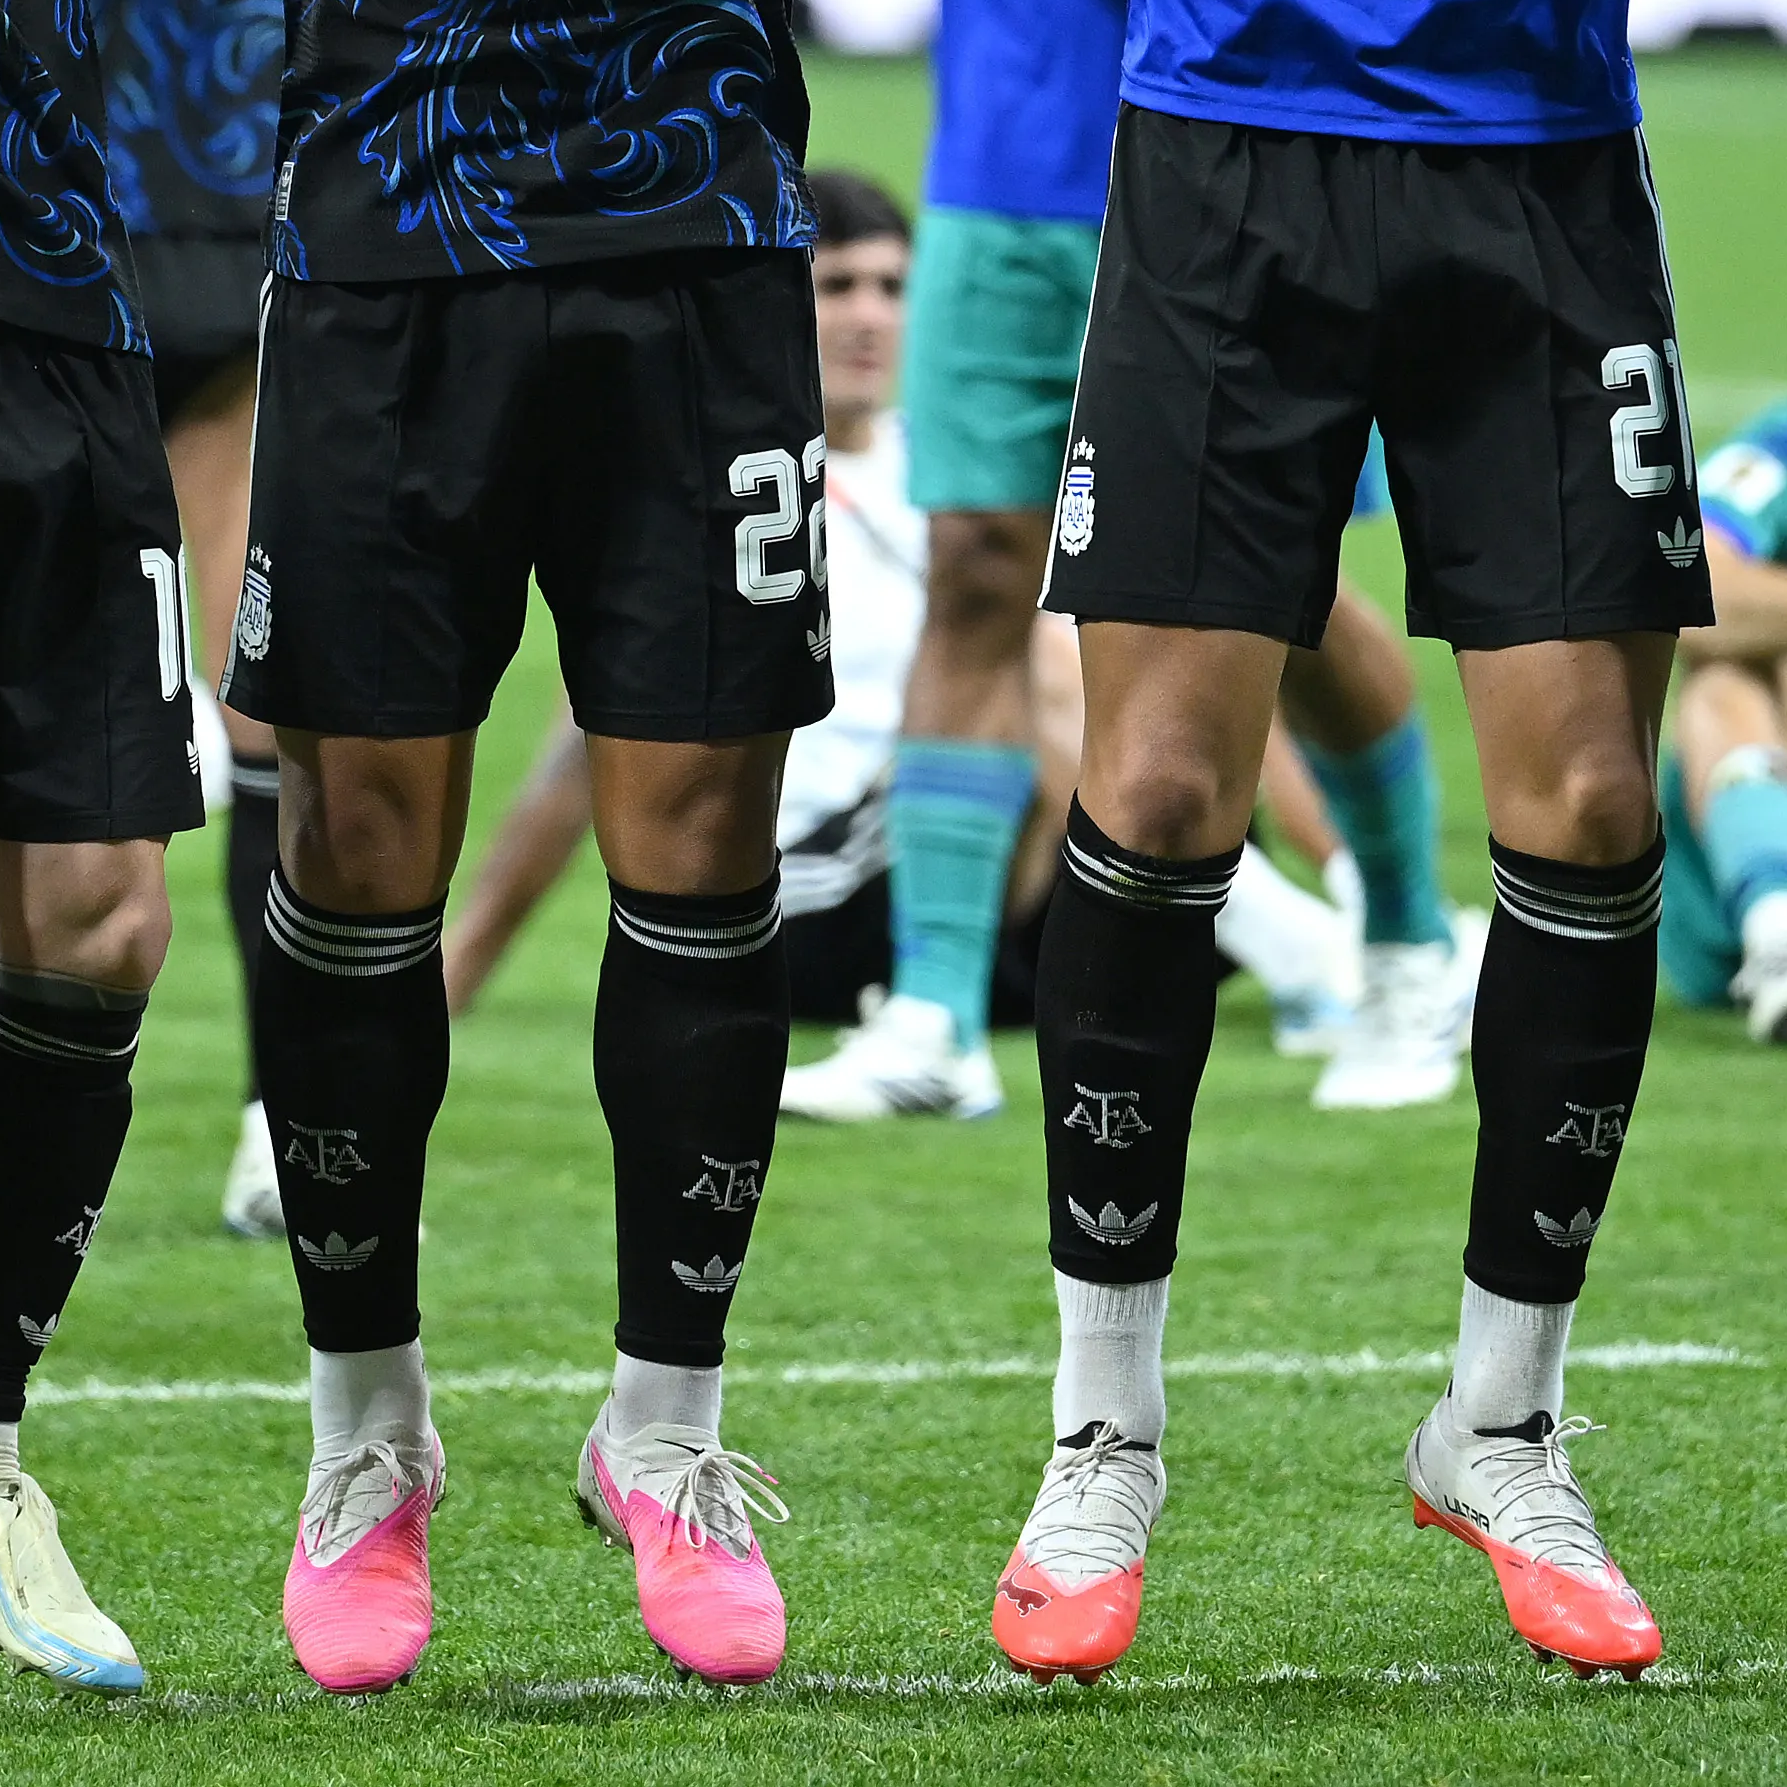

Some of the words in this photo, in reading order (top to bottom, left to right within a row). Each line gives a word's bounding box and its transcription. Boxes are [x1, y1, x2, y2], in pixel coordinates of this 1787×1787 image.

[140, 543, 194, 702] 1
[1064, 1082, 1152, 1149] AFA
[1546, 1101, 1628, 1157] AFA
[284, 1120, 370, 1184] AFA
[682, 1155, 760, 1212] AFA
[1443, 1494, 1490, 1533] ULTRA
